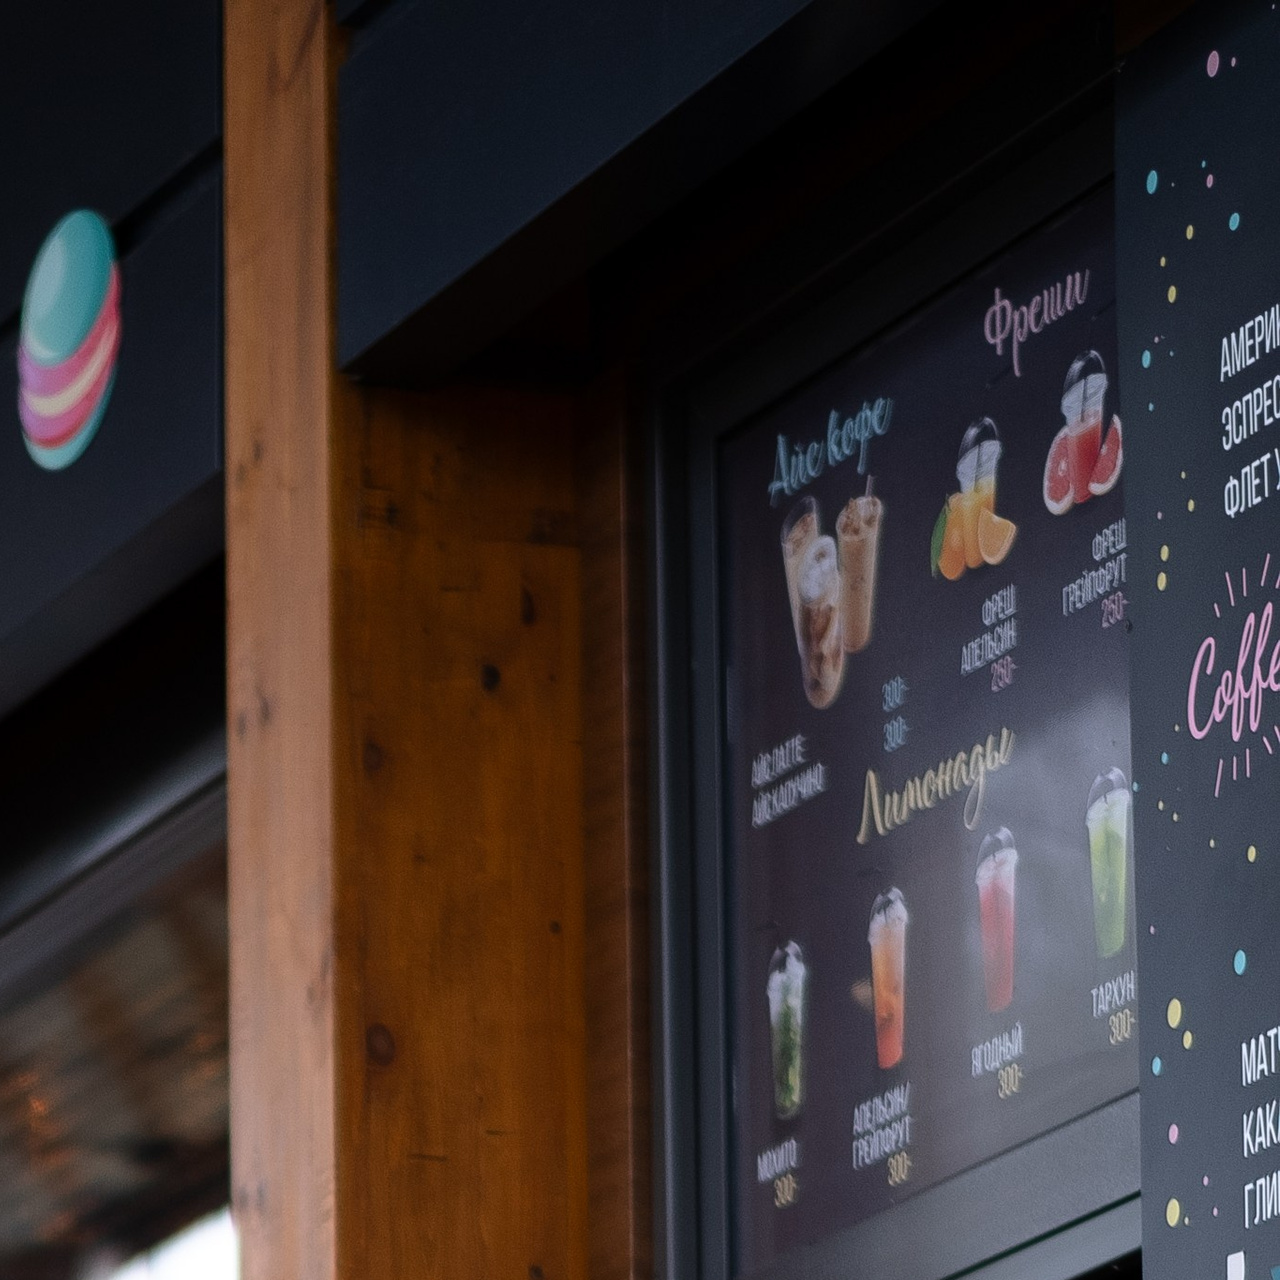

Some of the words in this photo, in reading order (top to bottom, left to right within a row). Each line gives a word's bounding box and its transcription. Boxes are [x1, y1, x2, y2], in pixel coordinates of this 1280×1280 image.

[984, 268, 1091, 377] Фреши
[1224, 452, 1271, 518] ФЛЕТ
[1092, 518, 1128, 562] ФРЕШ
[981, 583, 1017, 627] ФРЕШ
[960, 617, 1018, 676] АПЕЛЬСИН
[856, 726, 1015, 845] Лимонады
[1091, 969, 1135, 1018] ТАРХУН
[1241, 1026, 1280, 1087] МАТ
[1242, 1099, 1280, 1158] КАК
[1244, 1170, 1280, 1229] ГЛИ
